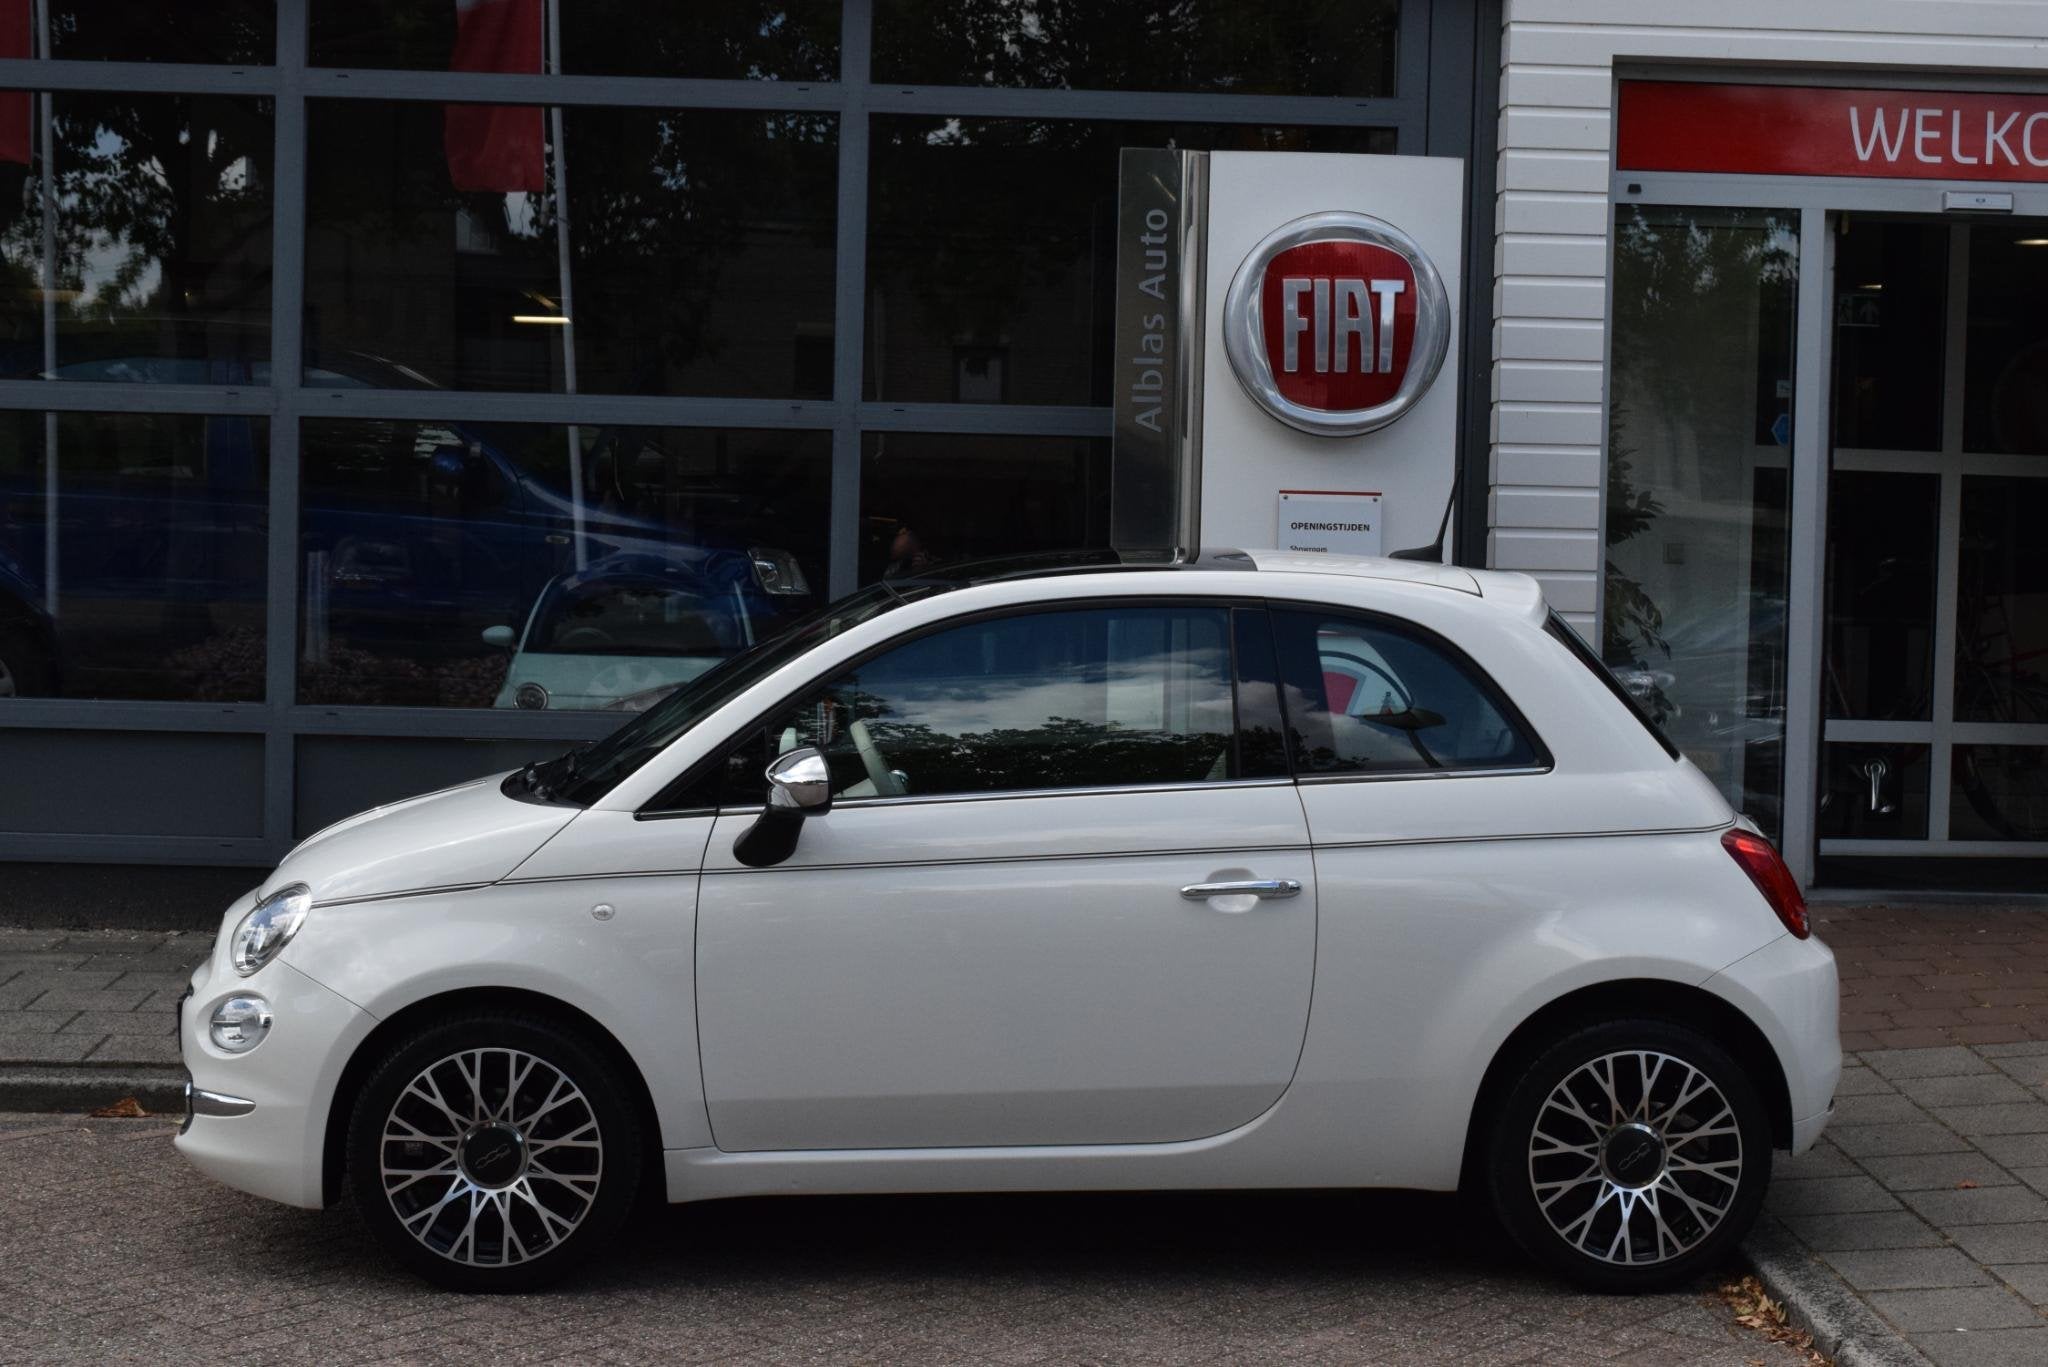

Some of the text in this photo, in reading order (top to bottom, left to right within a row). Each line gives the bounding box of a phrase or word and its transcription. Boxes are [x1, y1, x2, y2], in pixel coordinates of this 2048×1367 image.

[1130, 208, 1168, 433] Alblas Auto
[1282, 278, 1405, 373] FIAT
[1290, 522, 1370, 532] OPENINGSTIJDEN
